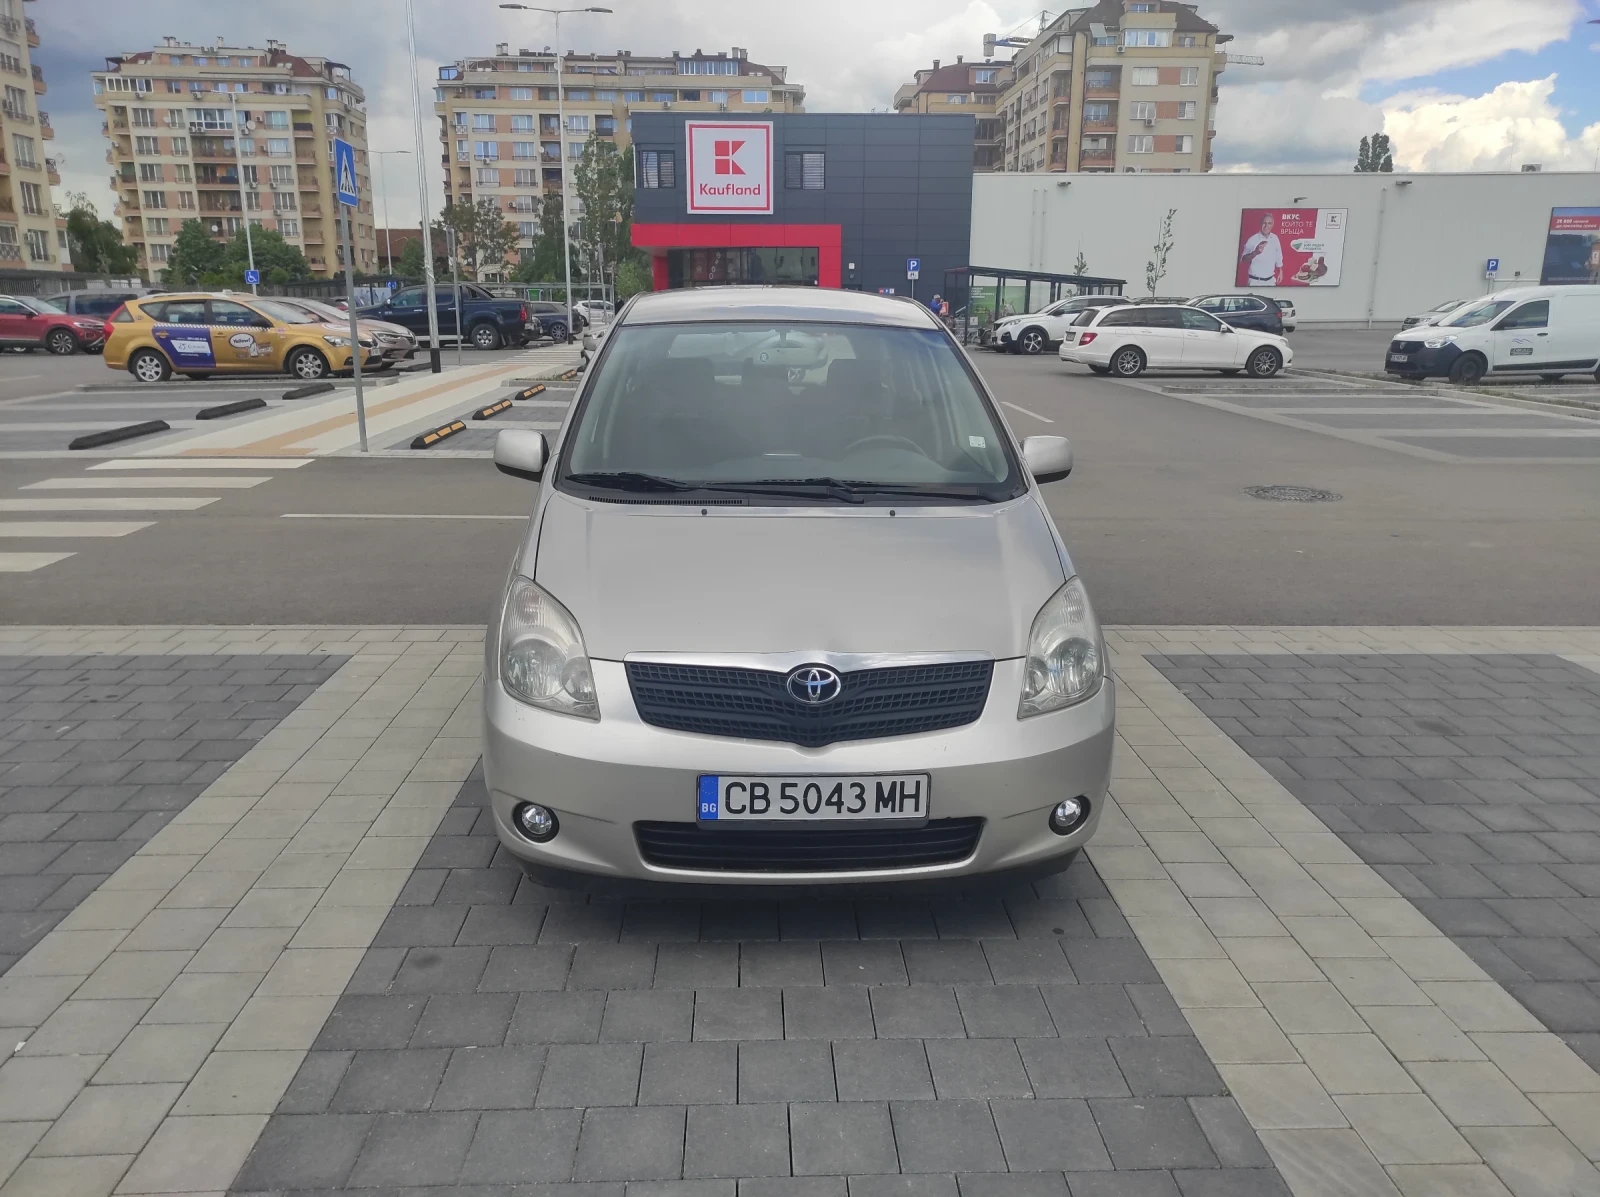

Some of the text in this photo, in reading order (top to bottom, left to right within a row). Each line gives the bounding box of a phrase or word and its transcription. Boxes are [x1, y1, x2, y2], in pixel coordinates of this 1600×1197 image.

[699, 183, 761, 196] Kaufland
[910, 260, 918, 270] P
[1489, 260, 1496, 270] P
[701, 780, 921, 815] BG CB 5043 MH
